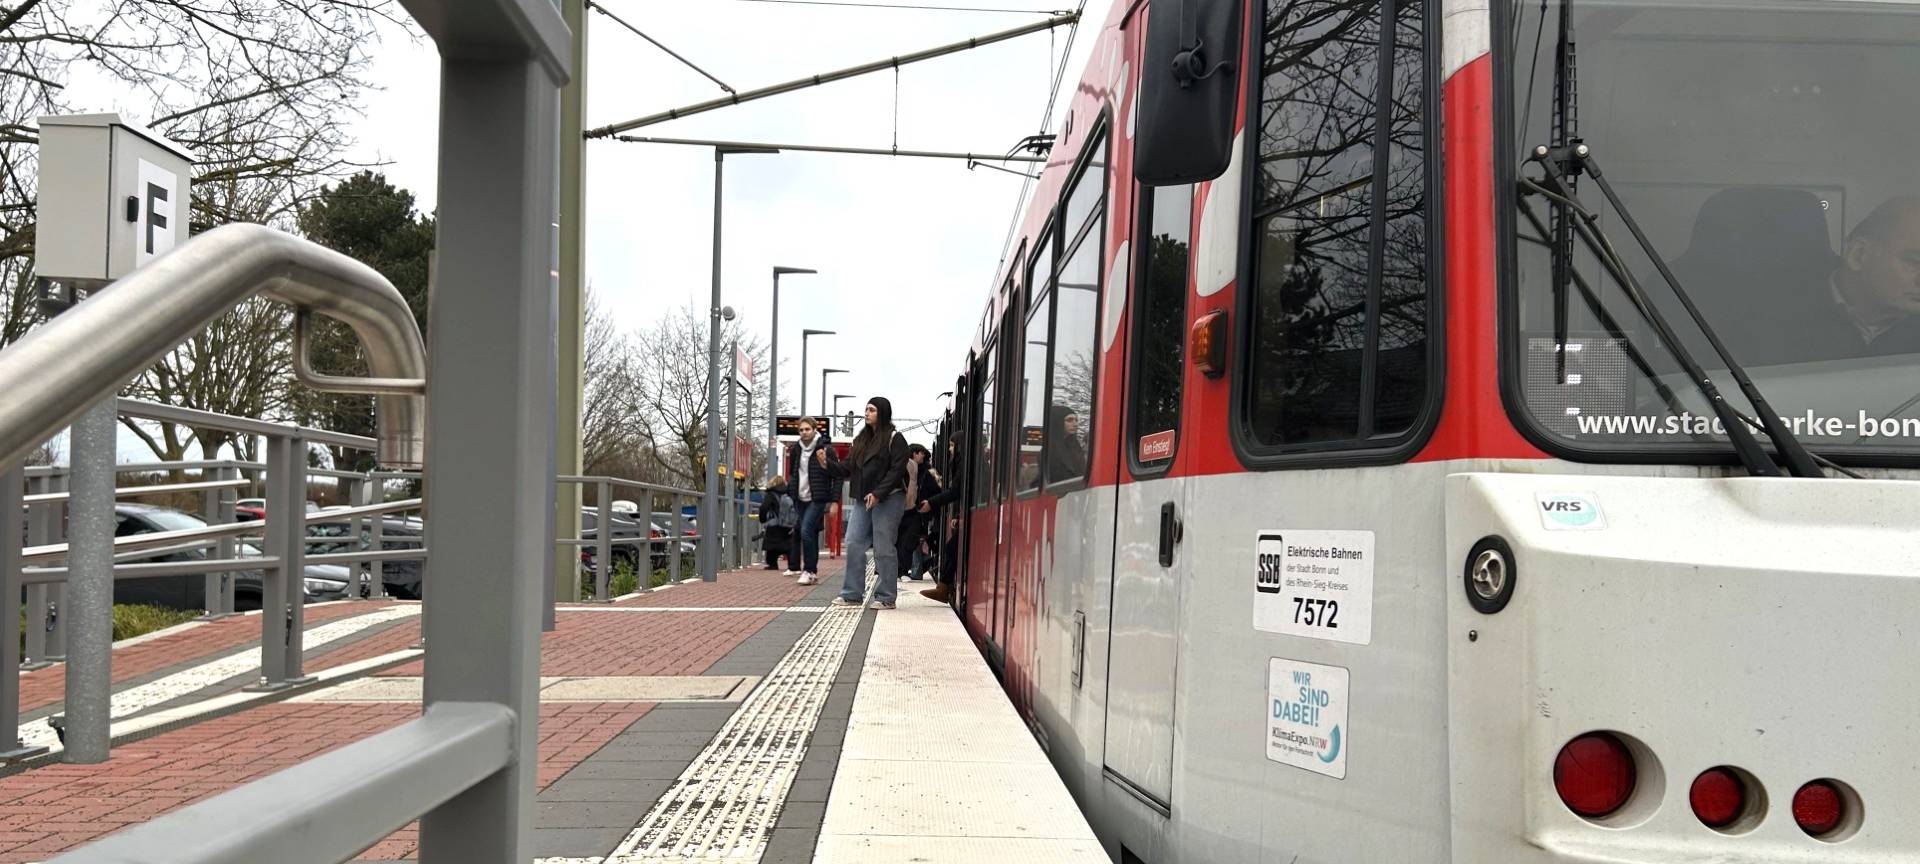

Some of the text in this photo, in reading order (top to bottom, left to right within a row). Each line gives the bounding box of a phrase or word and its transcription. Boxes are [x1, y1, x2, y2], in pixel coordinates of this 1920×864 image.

[146, 181, 168, 255] F
[1577, 408, 1920, 437] www.starke-bon
[1541, 501, 1581, 511] VRS
[1287, 545, 1362, 560] Elektrische Bahnen
[1258, 553, 1280, 584] SSB
[1286, 563, 1339, 575] der Stadt Bonn und
[1286, 578, 1349, 592] des Rhein-Sieg-Kreises
[1293, 597, 1338, 628] 7572
[1293, 671, 1311, 685] WIR
[1299, 686, 1329, 708] SIND
[1273, 698, 1319, 727] DABEI!
